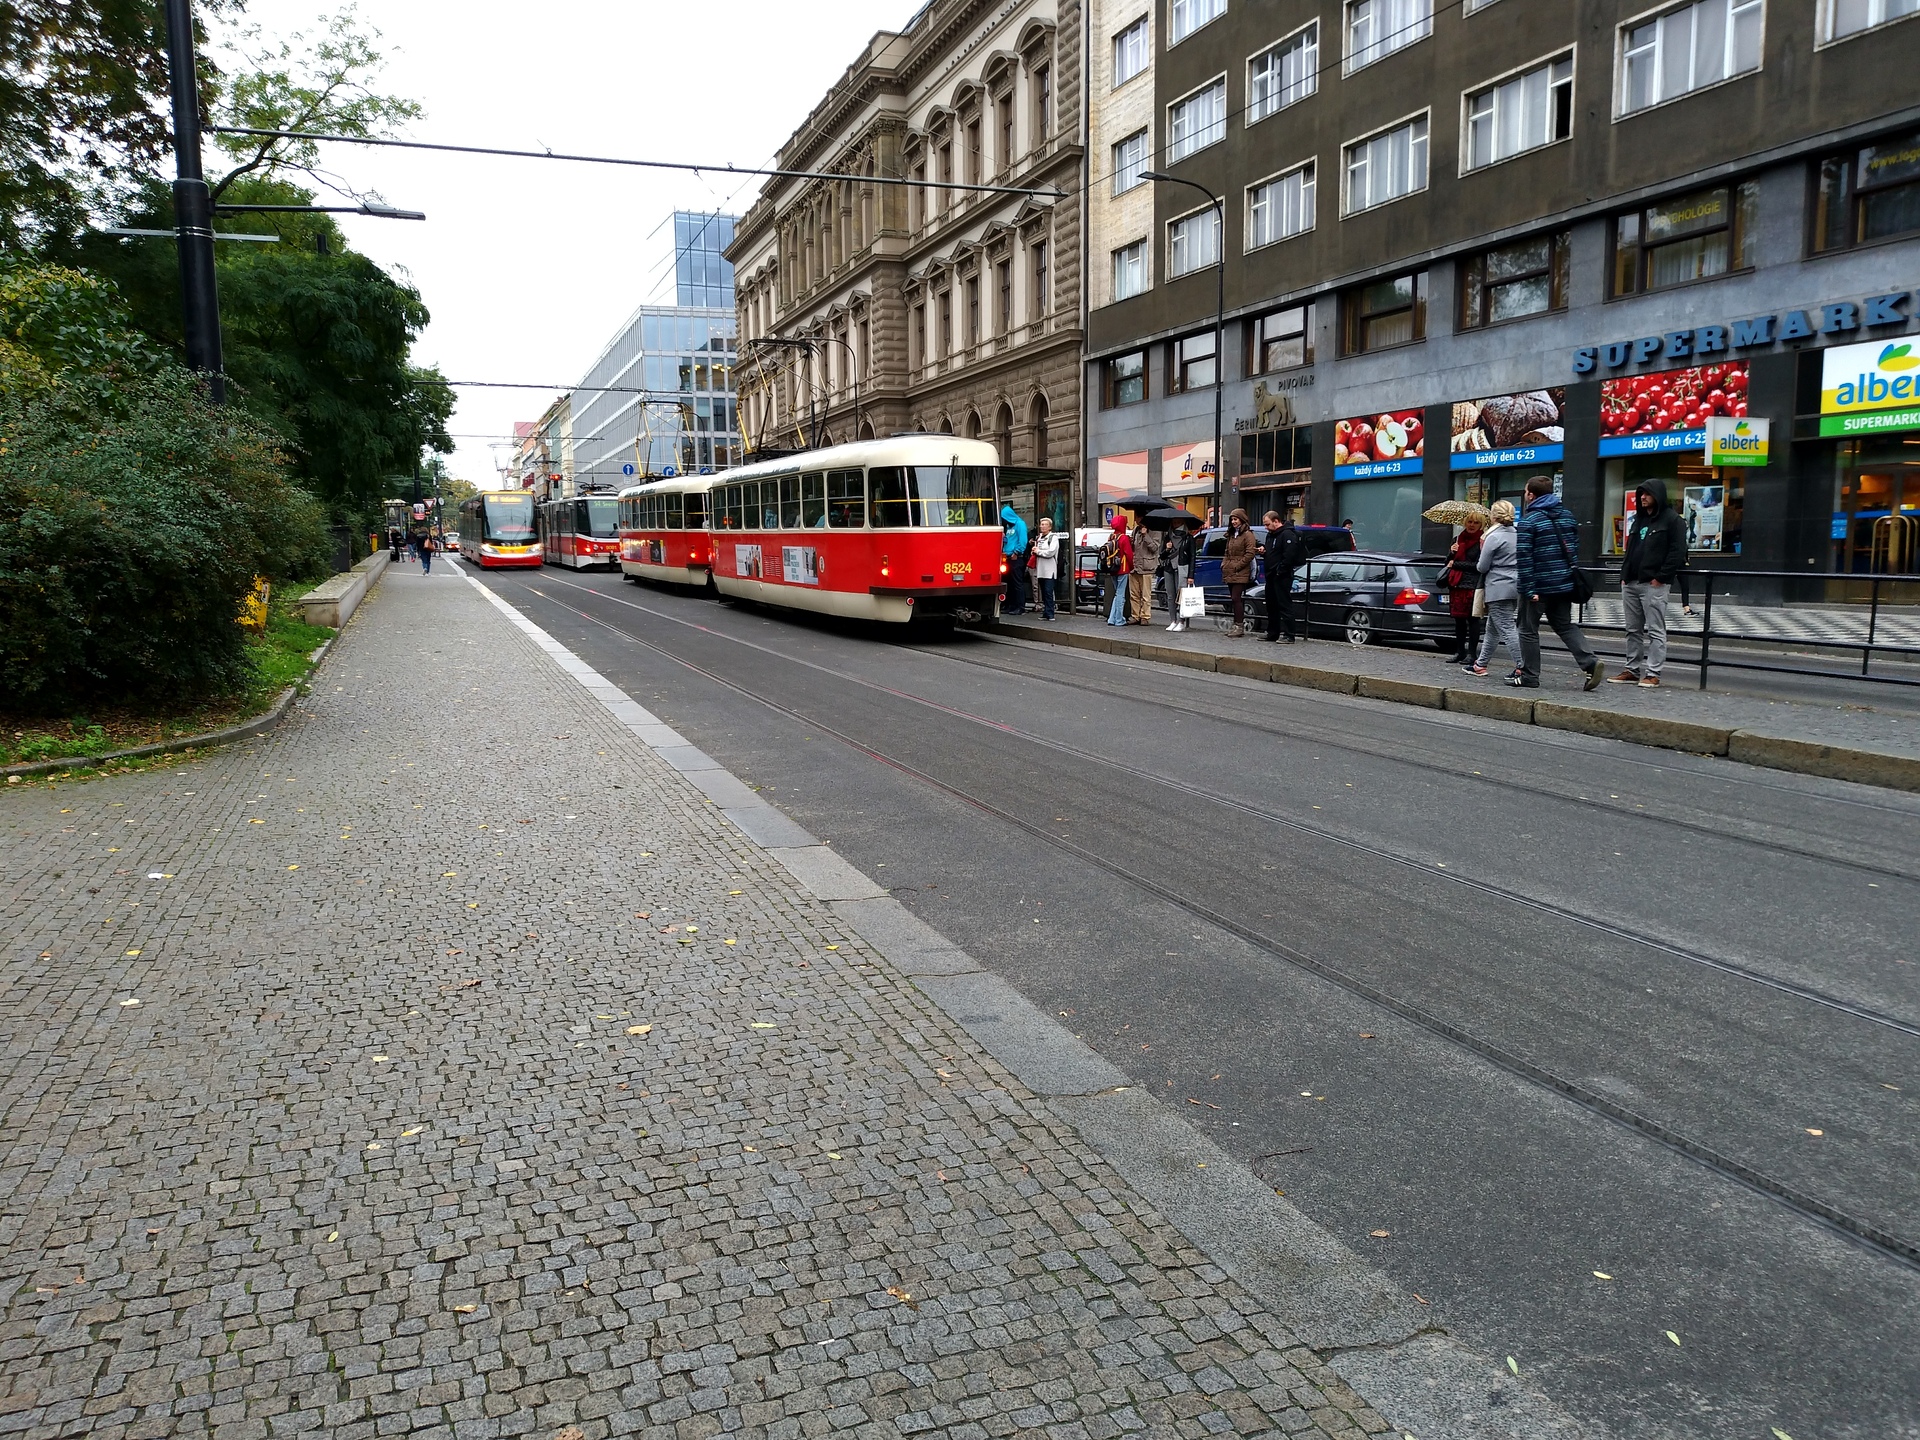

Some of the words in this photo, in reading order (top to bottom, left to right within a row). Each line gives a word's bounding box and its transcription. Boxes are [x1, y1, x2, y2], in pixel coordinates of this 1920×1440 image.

[1654, 201, 1720, 226] PSYCHOLOGIE
[1572, 289, 1920, 373] SUPERMARK
[1278, 375, 1314, 391] PIVOVAR
[1843, 413, 1920, 430] SUPERMARK
[1632, 436, 1660, 450] každý
[1663, 435, 1681, 447] den
[1685, 432, 1706, 445] 6-23
[1720, 434, 1759, 450] albert
[1476, 453, 1498, 464] každý
[1500, 451, 1514, 461] den
[1517, 449, 1535, 459] 6-23
[1354, 465, 1371, 476] každý
[1373, 464, 1384, 474] den
[1386, 462, 1401, 472] 6-23
[945, 509, 965, 523] 24
[944, 562, 972, 574] 8524
